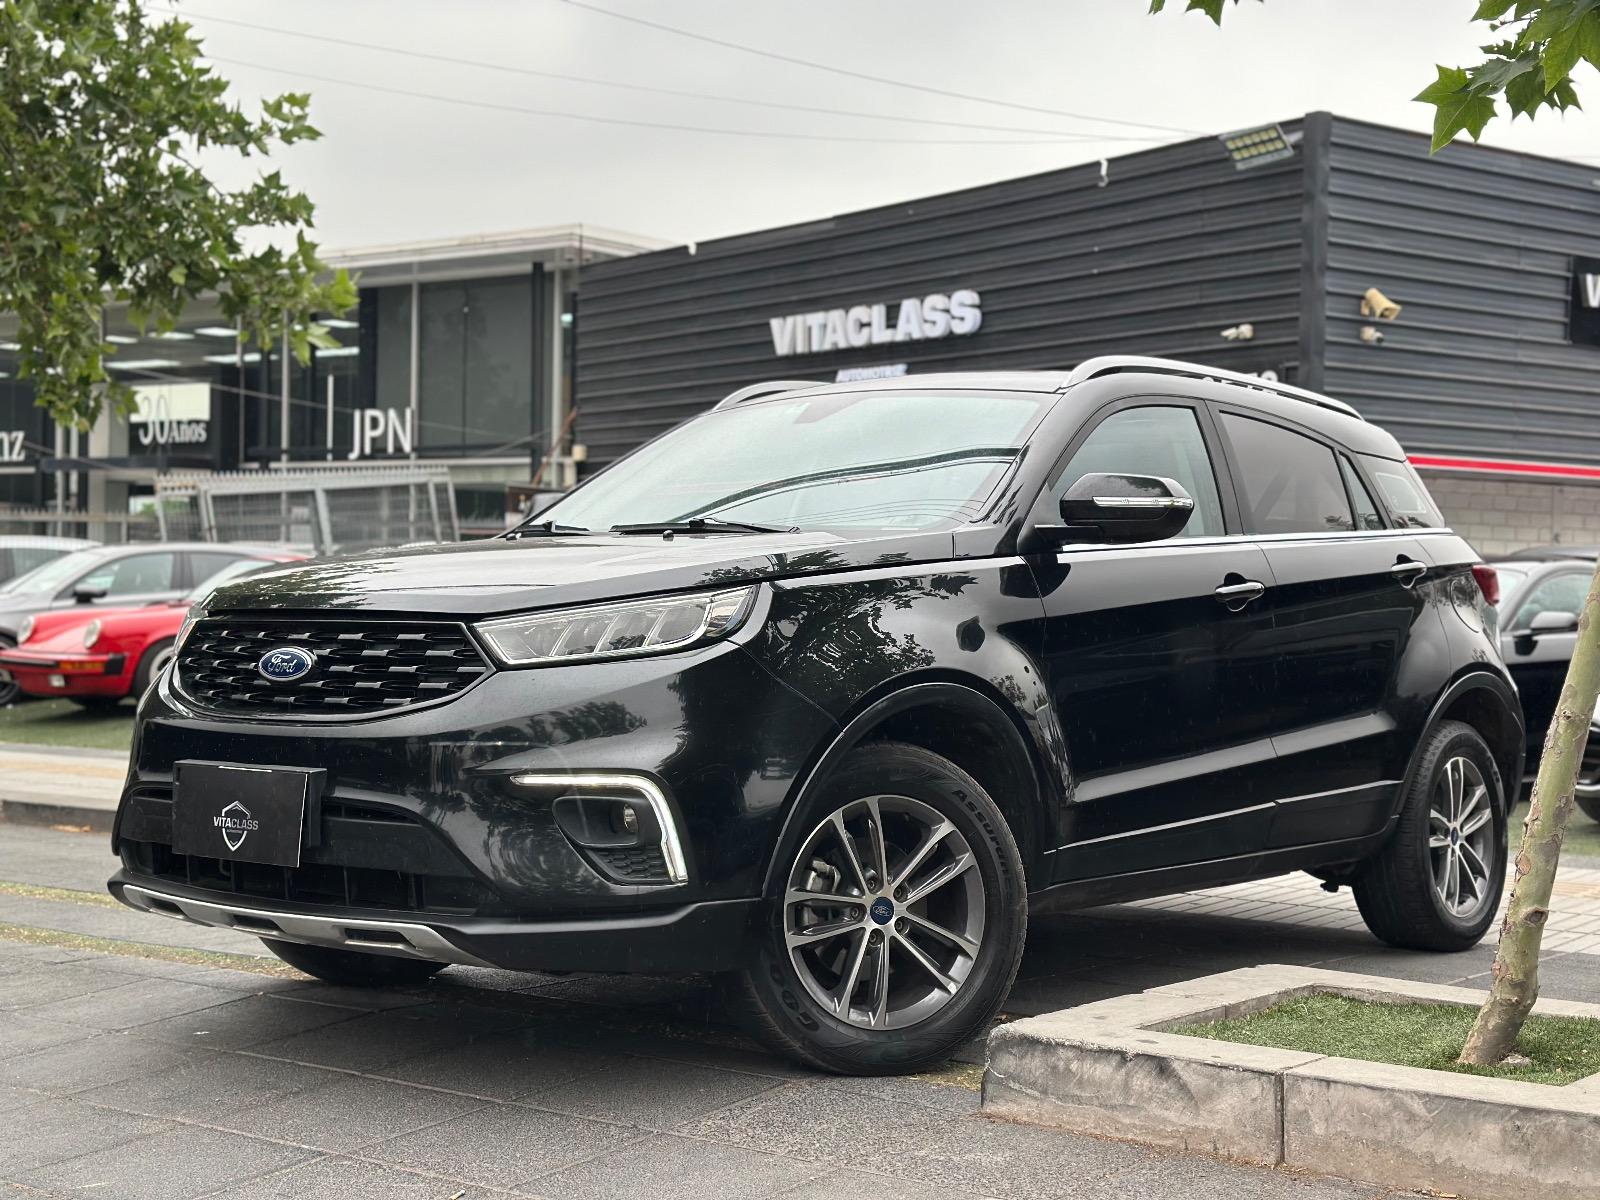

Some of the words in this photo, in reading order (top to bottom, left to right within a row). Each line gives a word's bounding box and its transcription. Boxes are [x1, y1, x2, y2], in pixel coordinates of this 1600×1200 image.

[769, 289, 982, 357] VITACLASS
[347, 407, 412, 460] JPN
[267, 653, 298, 673] Ford
[213, 815, 259, 831] VITACLASS
